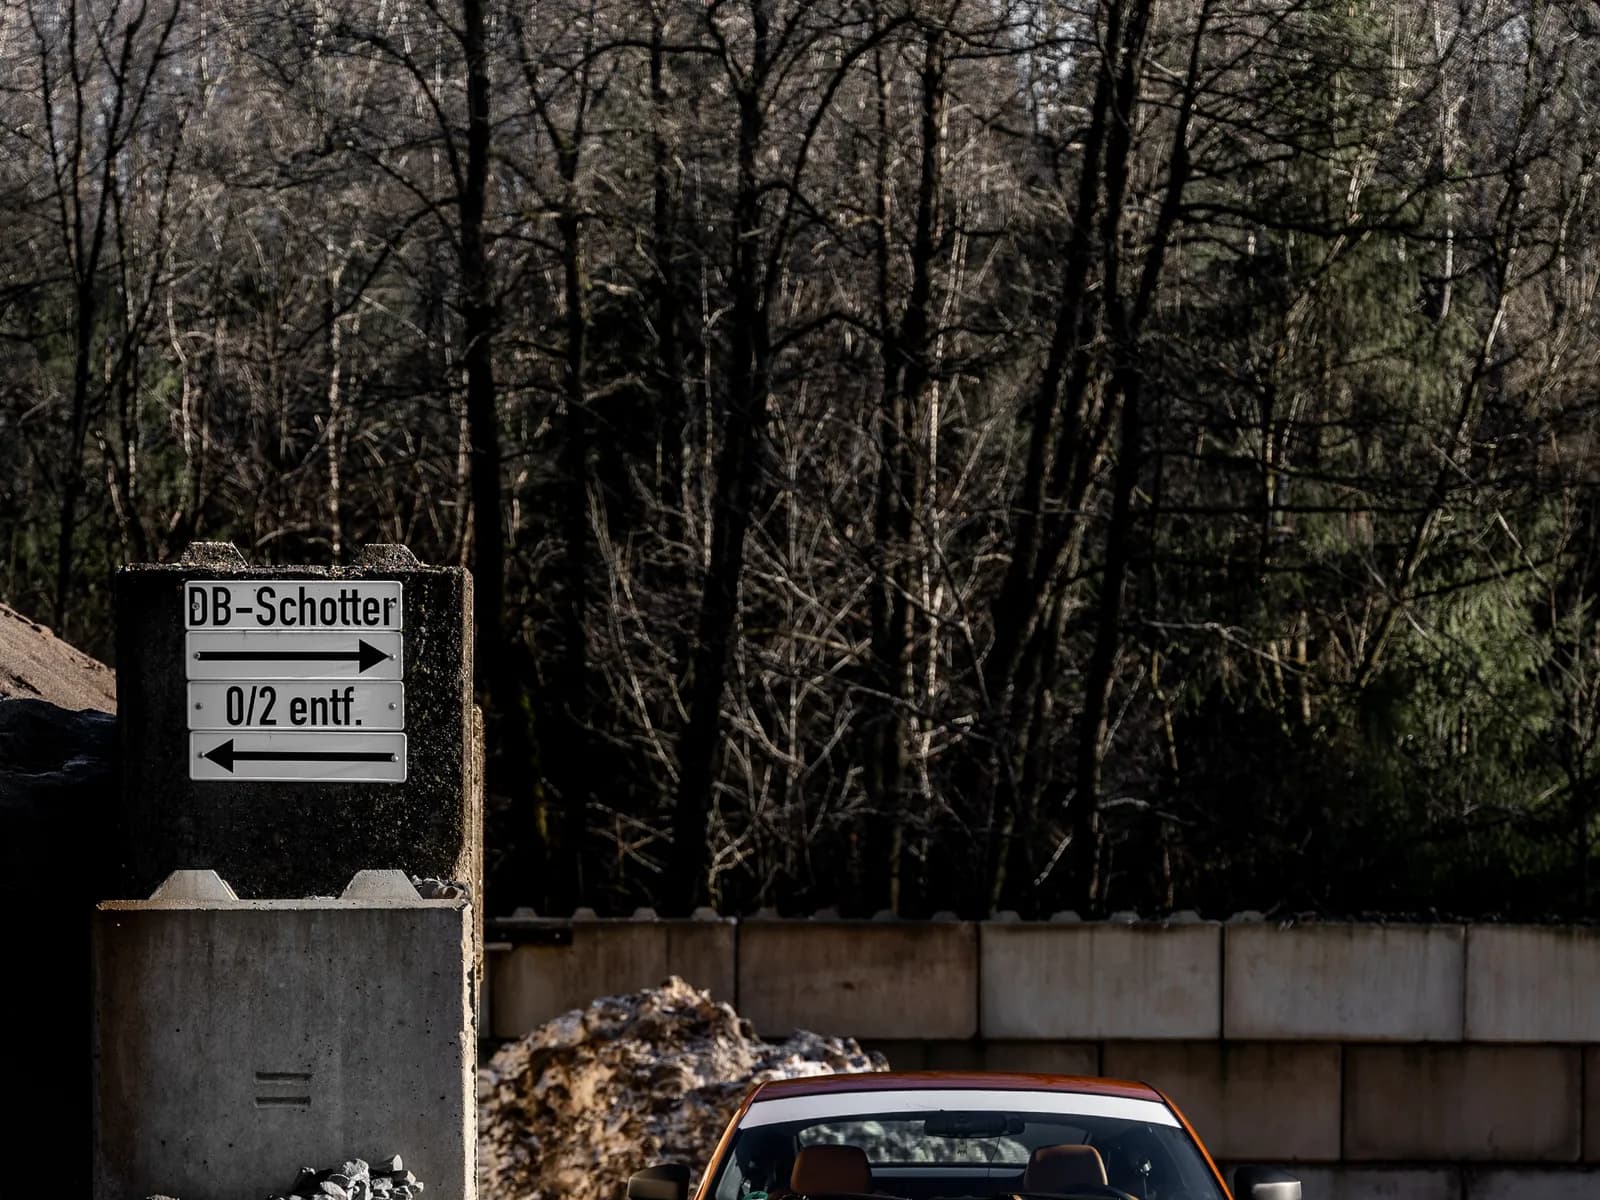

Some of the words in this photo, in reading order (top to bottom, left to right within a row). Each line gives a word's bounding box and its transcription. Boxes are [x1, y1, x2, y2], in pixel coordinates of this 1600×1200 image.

[188, 586, 397, 626] DB-Schotter
[226, 686, 277, 726] 0/2
[289, 686, 362, 726] entf.
